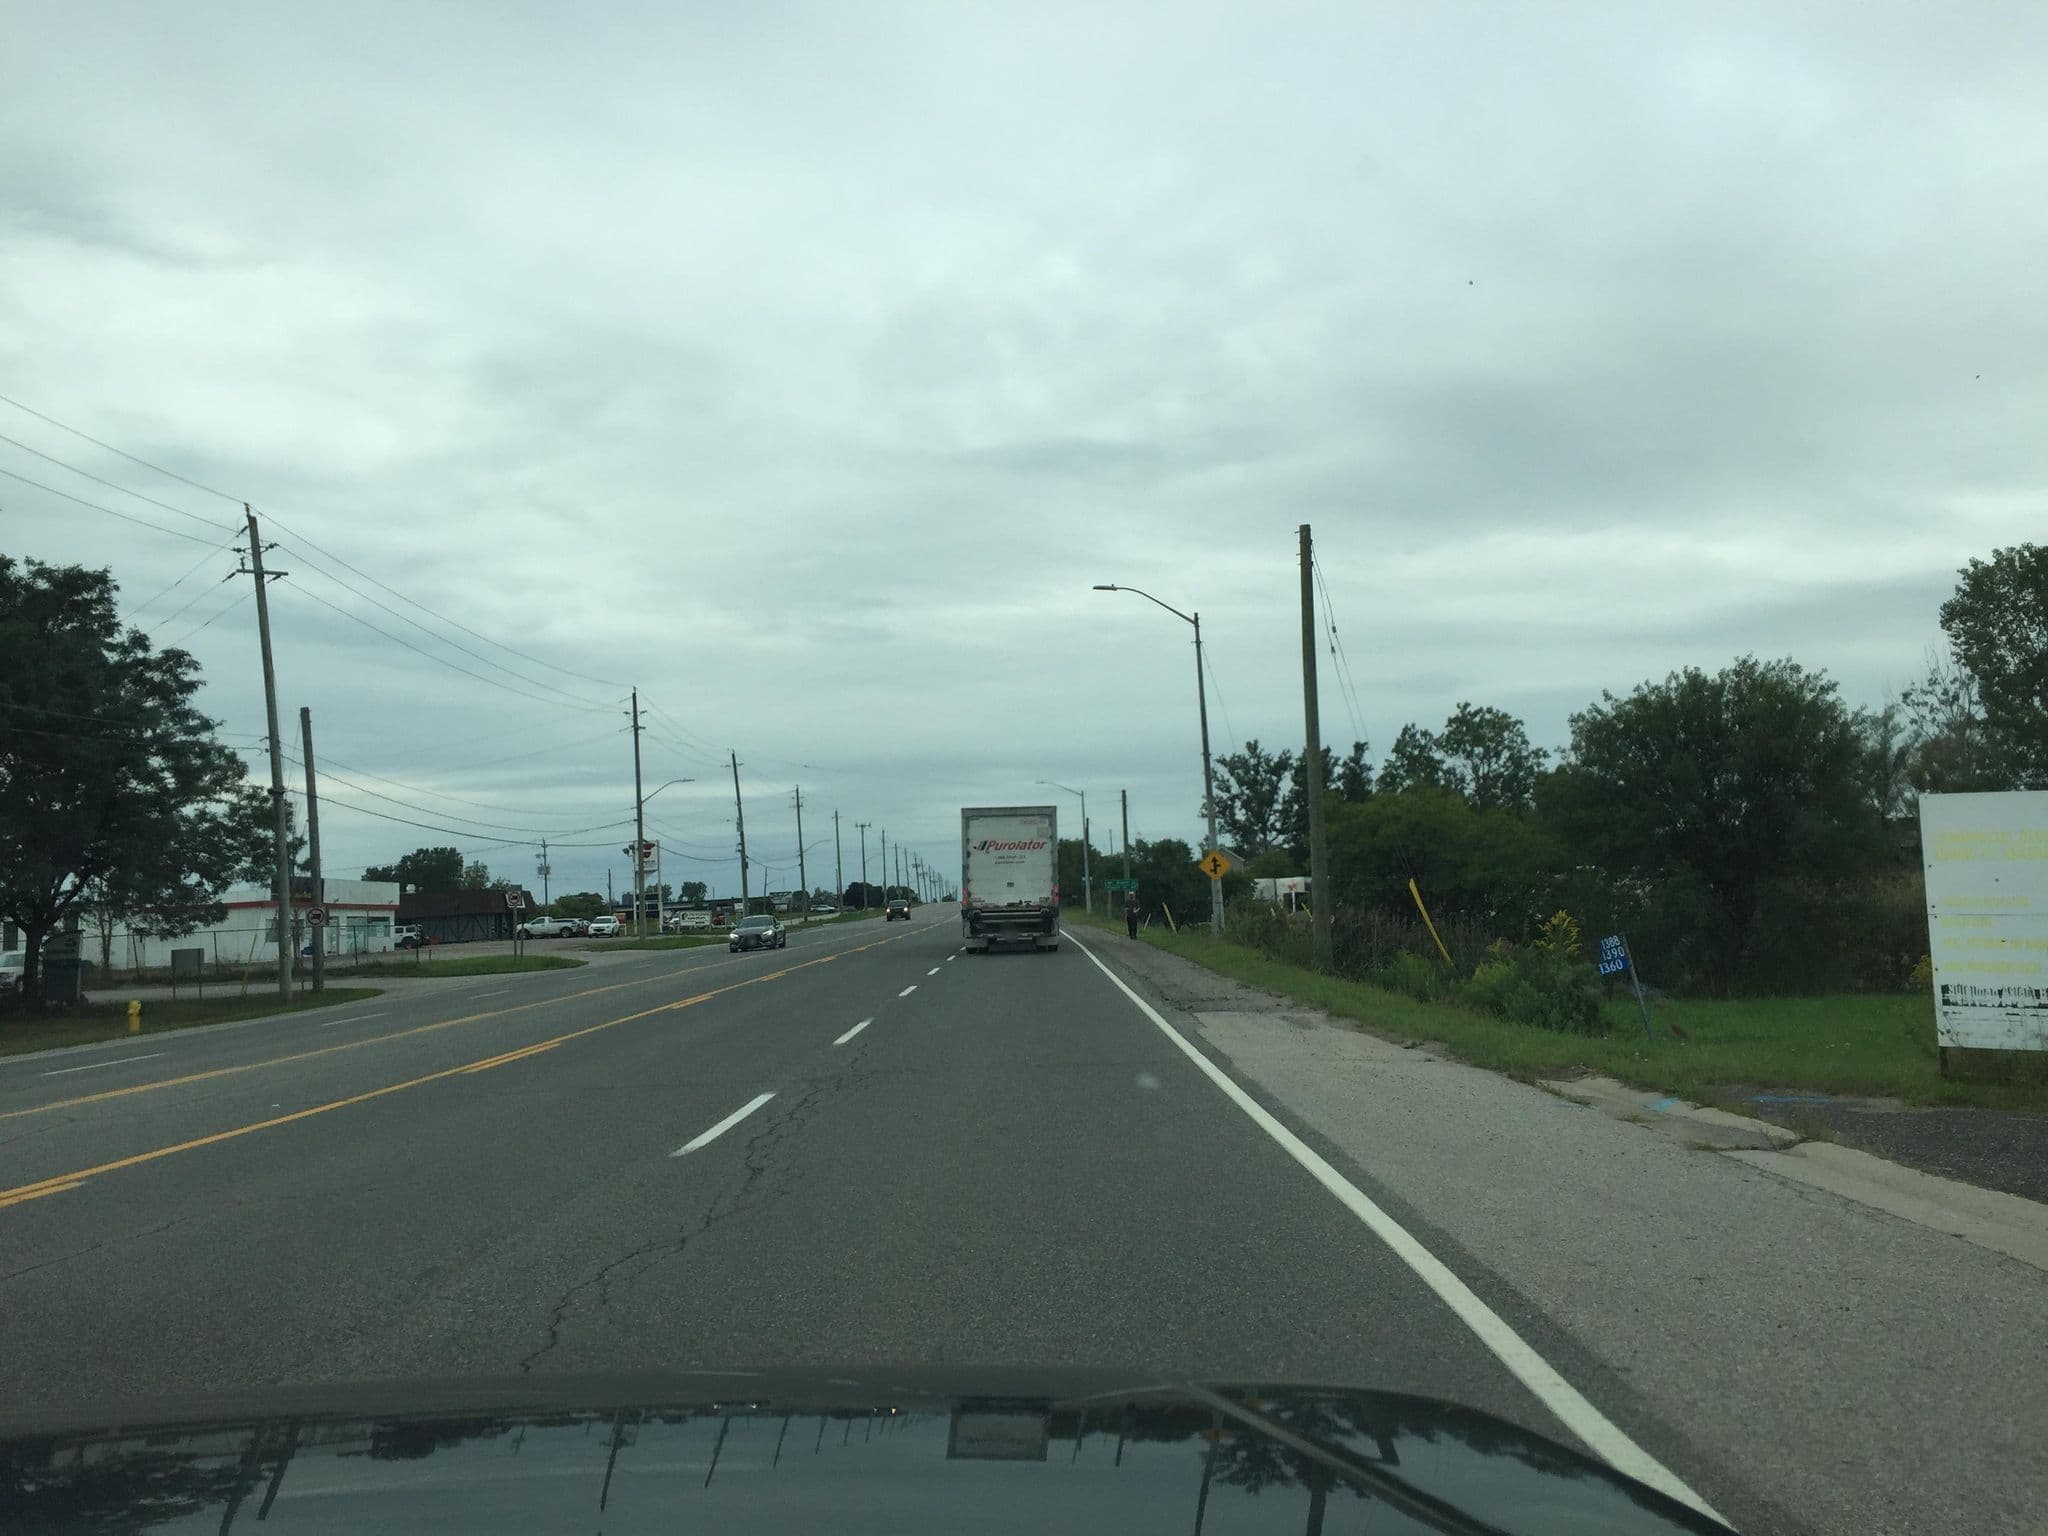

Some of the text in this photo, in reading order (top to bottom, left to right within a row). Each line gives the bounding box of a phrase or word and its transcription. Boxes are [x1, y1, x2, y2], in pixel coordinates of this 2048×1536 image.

[986, 840, 1047, 851] Purolator
[1601, 935, 1620, 950] 1388
[1602, 946, 1625, 960] 1390
[1599, 959, 1623, 974] 1360
